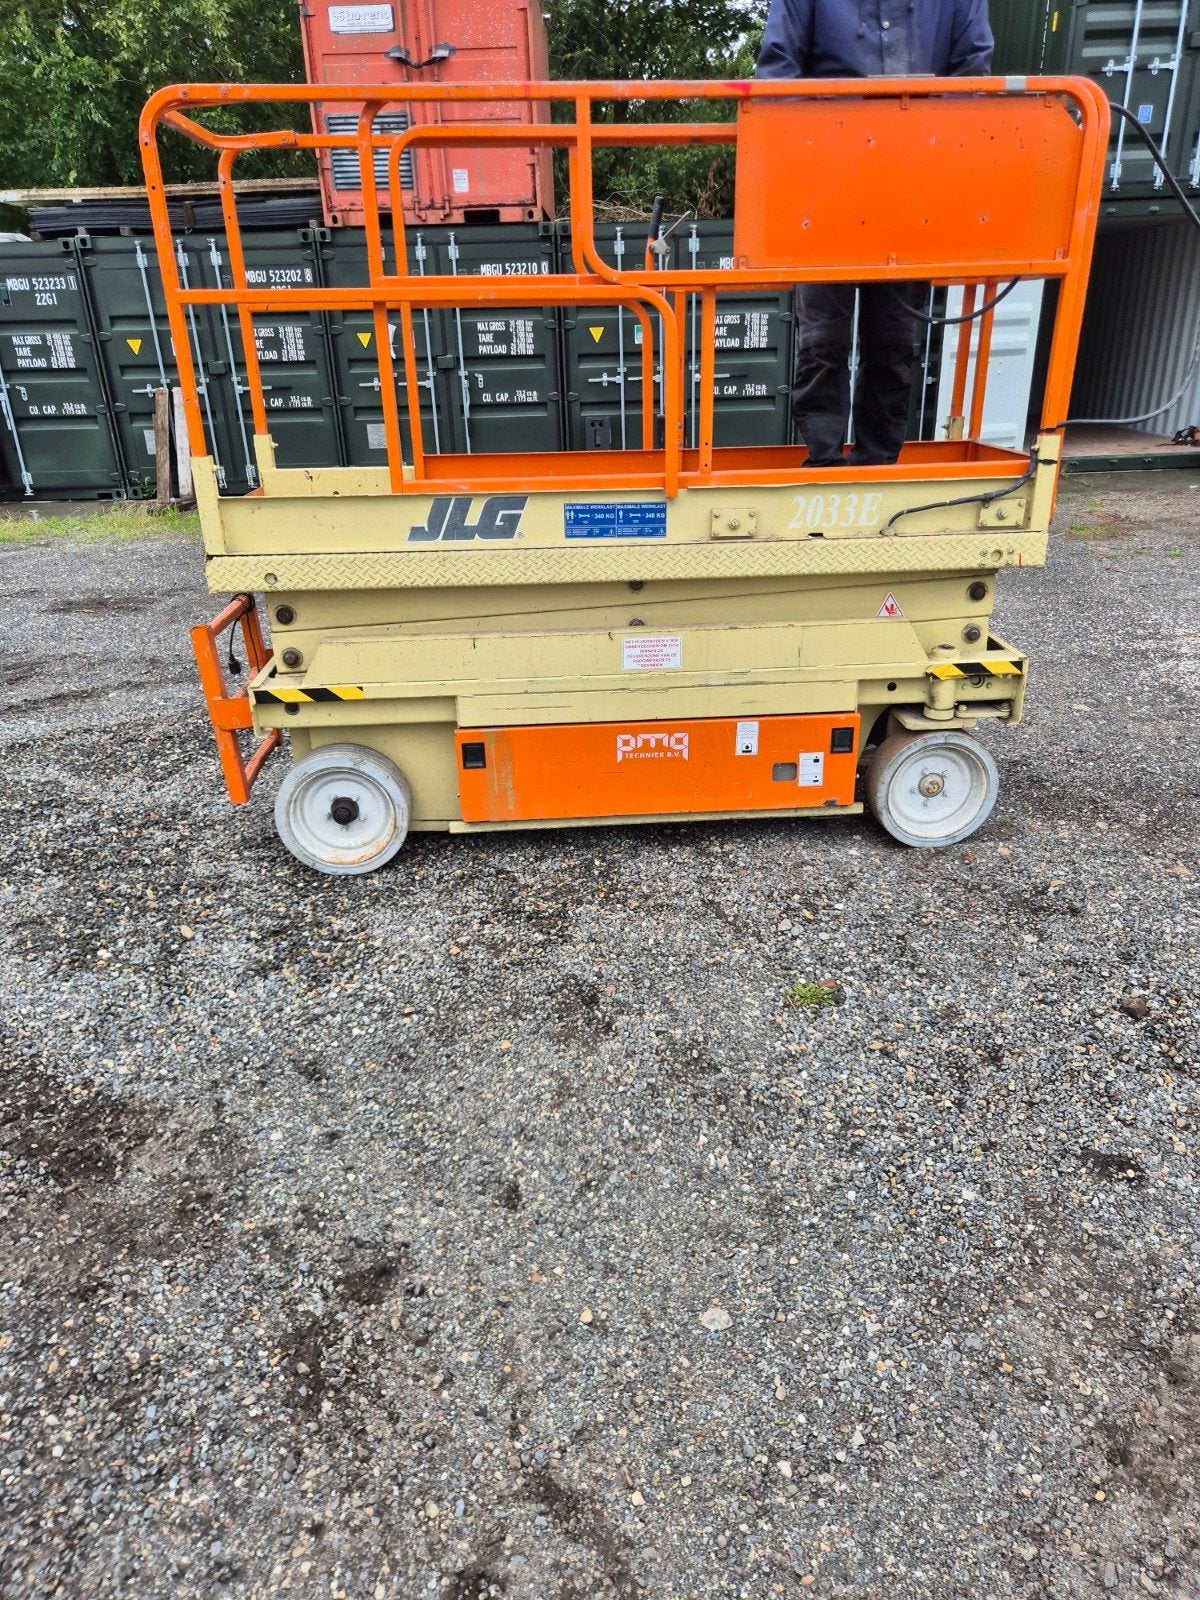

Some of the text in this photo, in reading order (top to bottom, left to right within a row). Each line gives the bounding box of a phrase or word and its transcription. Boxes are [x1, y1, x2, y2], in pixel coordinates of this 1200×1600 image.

[480, 263, 502, 275] MBGU
[505, 262, 538, 275] 523210
[245, 270, 266, 283] MBGU
[269, 270, 302, 282] 523202
[6, 277, 30, 291] MBGU
[32, 277, 66, 290] 523233
[35, 293, 58, 306] 22G1
[724, 315, 740, 324] GROSS
[477, 321, 506, 331] MAX GROSS
[258, 328, 275, 337] GROSS
[714, 327, 727, 336] ARE
[12, 335, 42, 346] MAX GROSS
[478, 333, 494, 342] TARE
[714, 338, 740, 348] AYLOAD
[14, 347, 32, 357] TARE
[478, 344, 507, 354] PAYLOAD
[17, 358, 47, 368] PAYLOAD
[724, 385, 738, 395] CAP.
[270, 398, 285, 407] CAP.
[482, 393, 510, 402] CU. CAP.
[29, 405, 59, 415] CU. CAP.
[787, 492, 883, 528] 2033E
[406, 496, 529, 542] JLG
